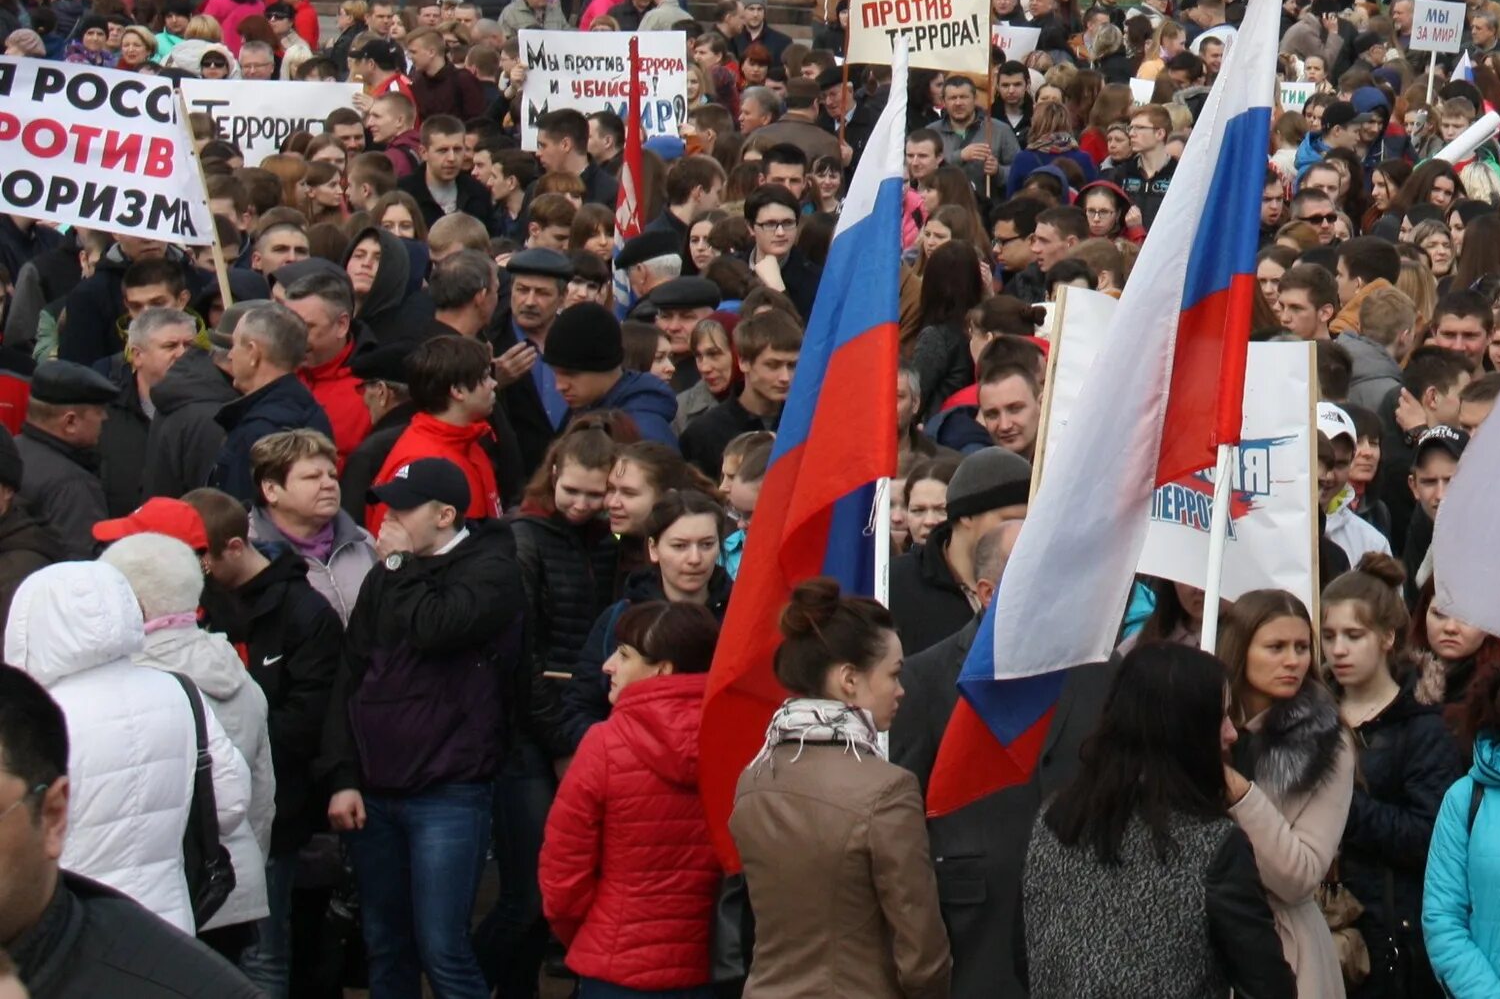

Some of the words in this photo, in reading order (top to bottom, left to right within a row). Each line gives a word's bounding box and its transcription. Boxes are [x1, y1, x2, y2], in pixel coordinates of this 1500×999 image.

[1425, 8, 1450, 24] МЫ
[885, 14, 981, 54] ТЕРРОРА!
[1416, 25, 1428, 42] ЗА
[1432, 22, 1459, 42] МИР!
[0, 169, 198, 237] ОРИЗМА
